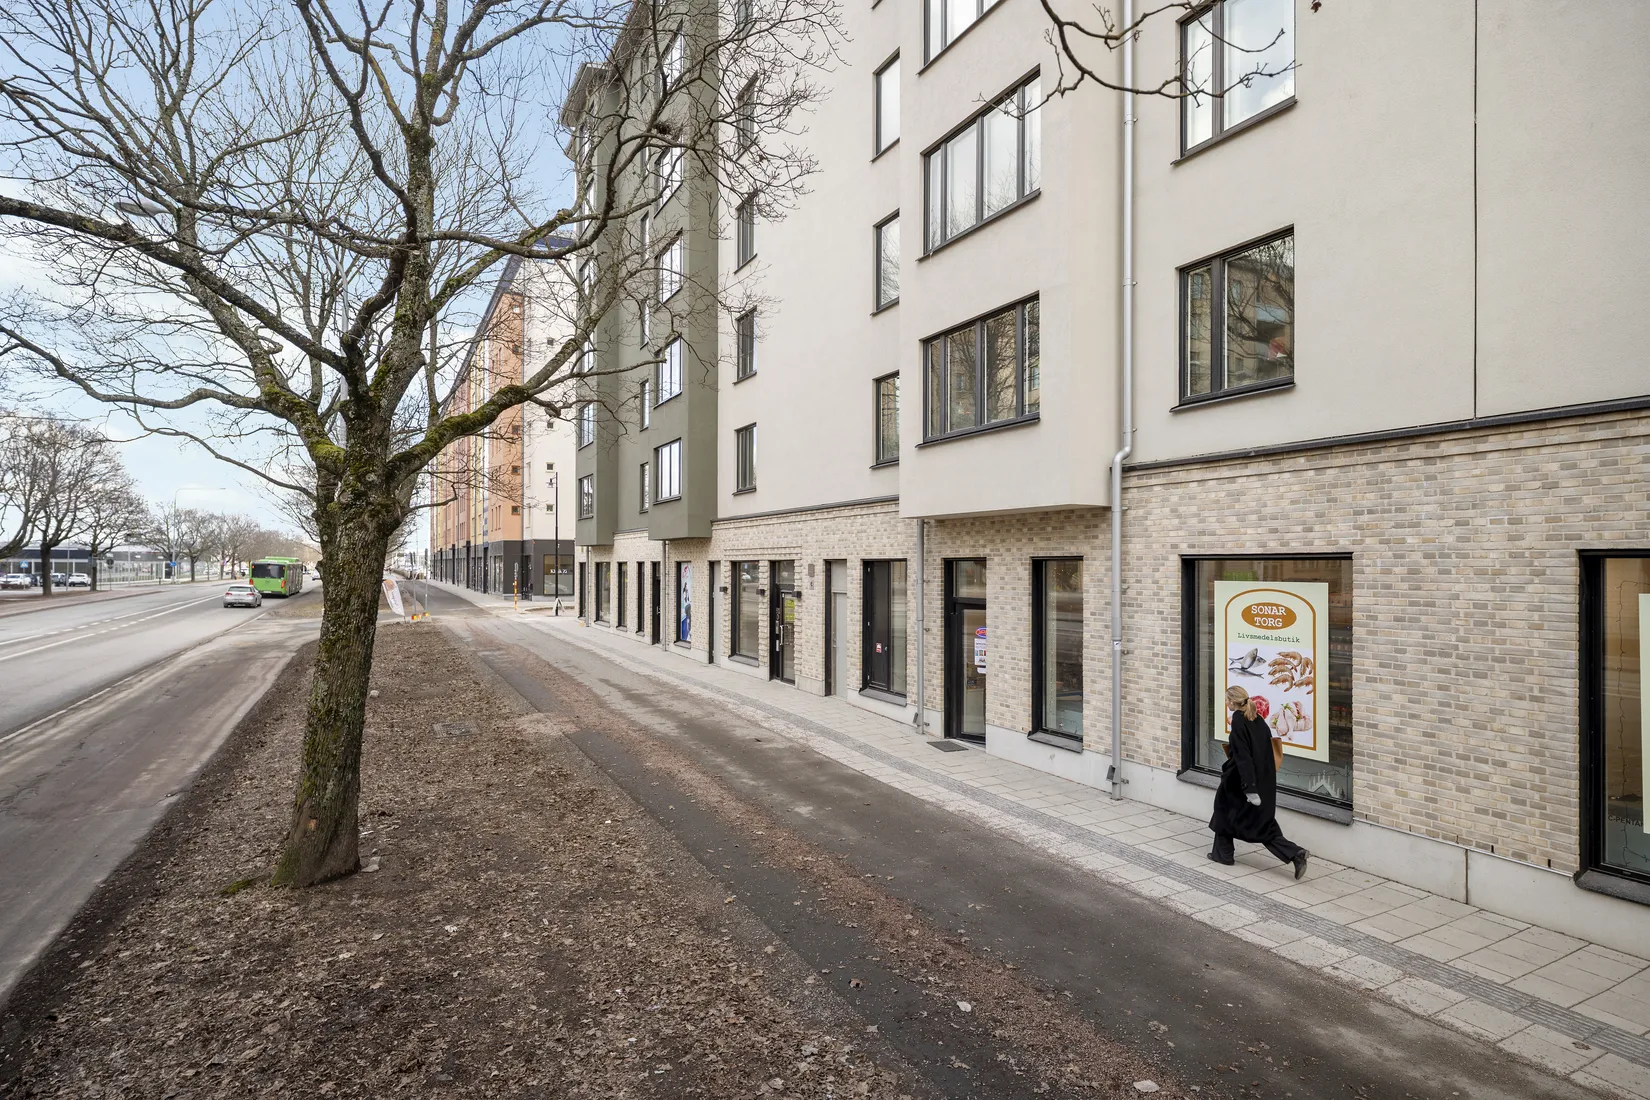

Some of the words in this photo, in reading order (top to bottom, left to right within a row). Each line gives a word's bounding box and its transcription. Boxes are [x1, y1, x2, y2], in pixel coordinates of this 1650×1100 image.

[1251, 605, 1287, 616] SONAR
[1254, 617, 1283, 627] TORG
[1237, 632, 1300, 643] Livsmedelsbutik
